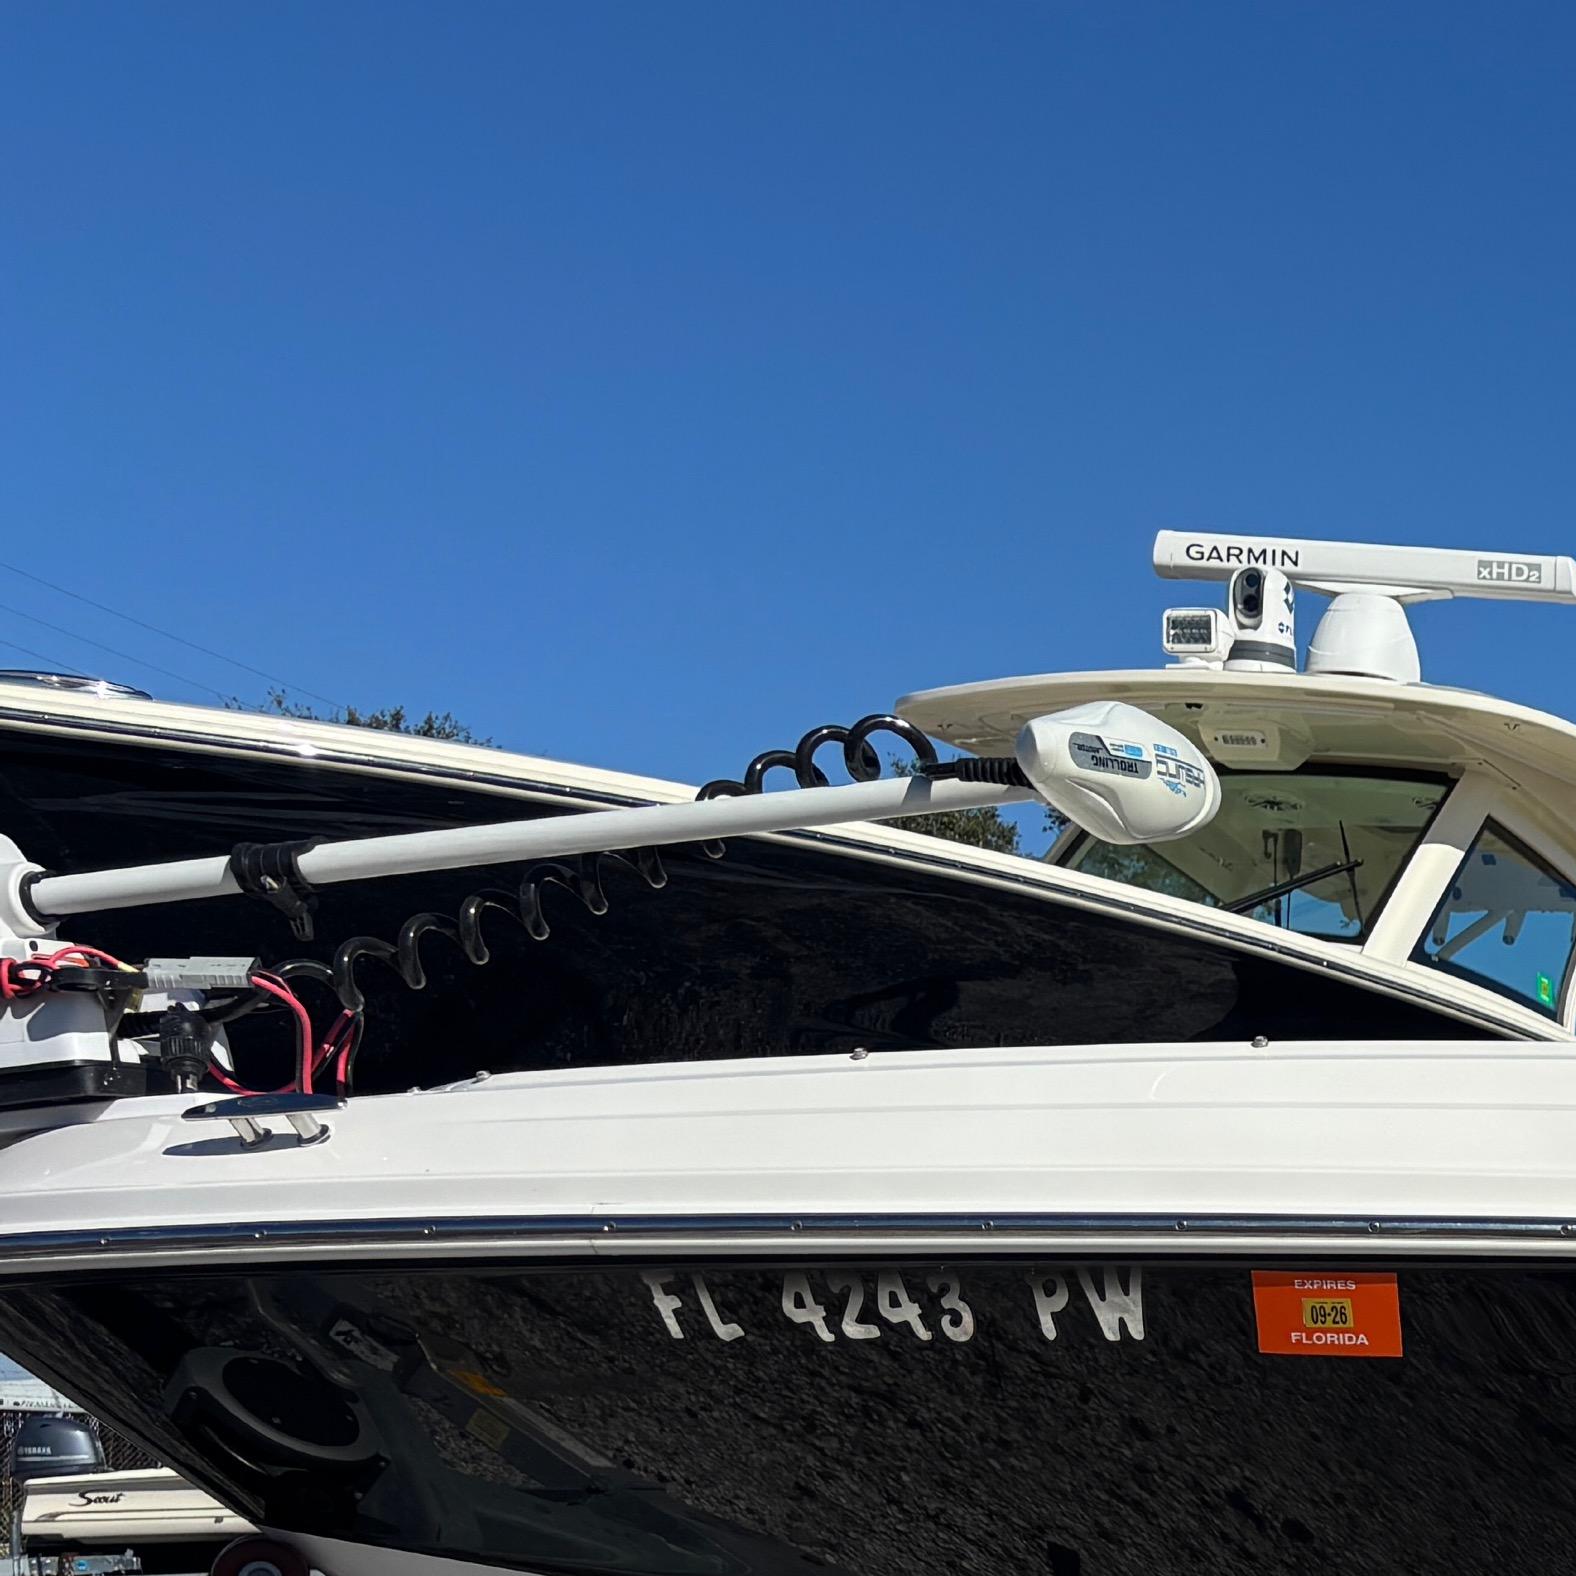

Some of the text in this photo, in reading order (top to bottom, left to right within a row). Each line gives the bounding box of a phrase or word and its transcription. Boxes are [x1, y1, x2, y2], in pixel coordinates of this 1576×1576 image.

[1185, 543, 1300, 568] GARMIN
[1478, 561, 1541, 582] xHD2
[1090, 754, 1140, 775] TROLLING
[1294, 1279, 1357, 1290] EXPIRES
[640, 1267, 1146, 1343] FL 4243 PW
[1290, 1331, 1370, 1346] FLORIDA
[68, 1489, 126, 1507] Scout
